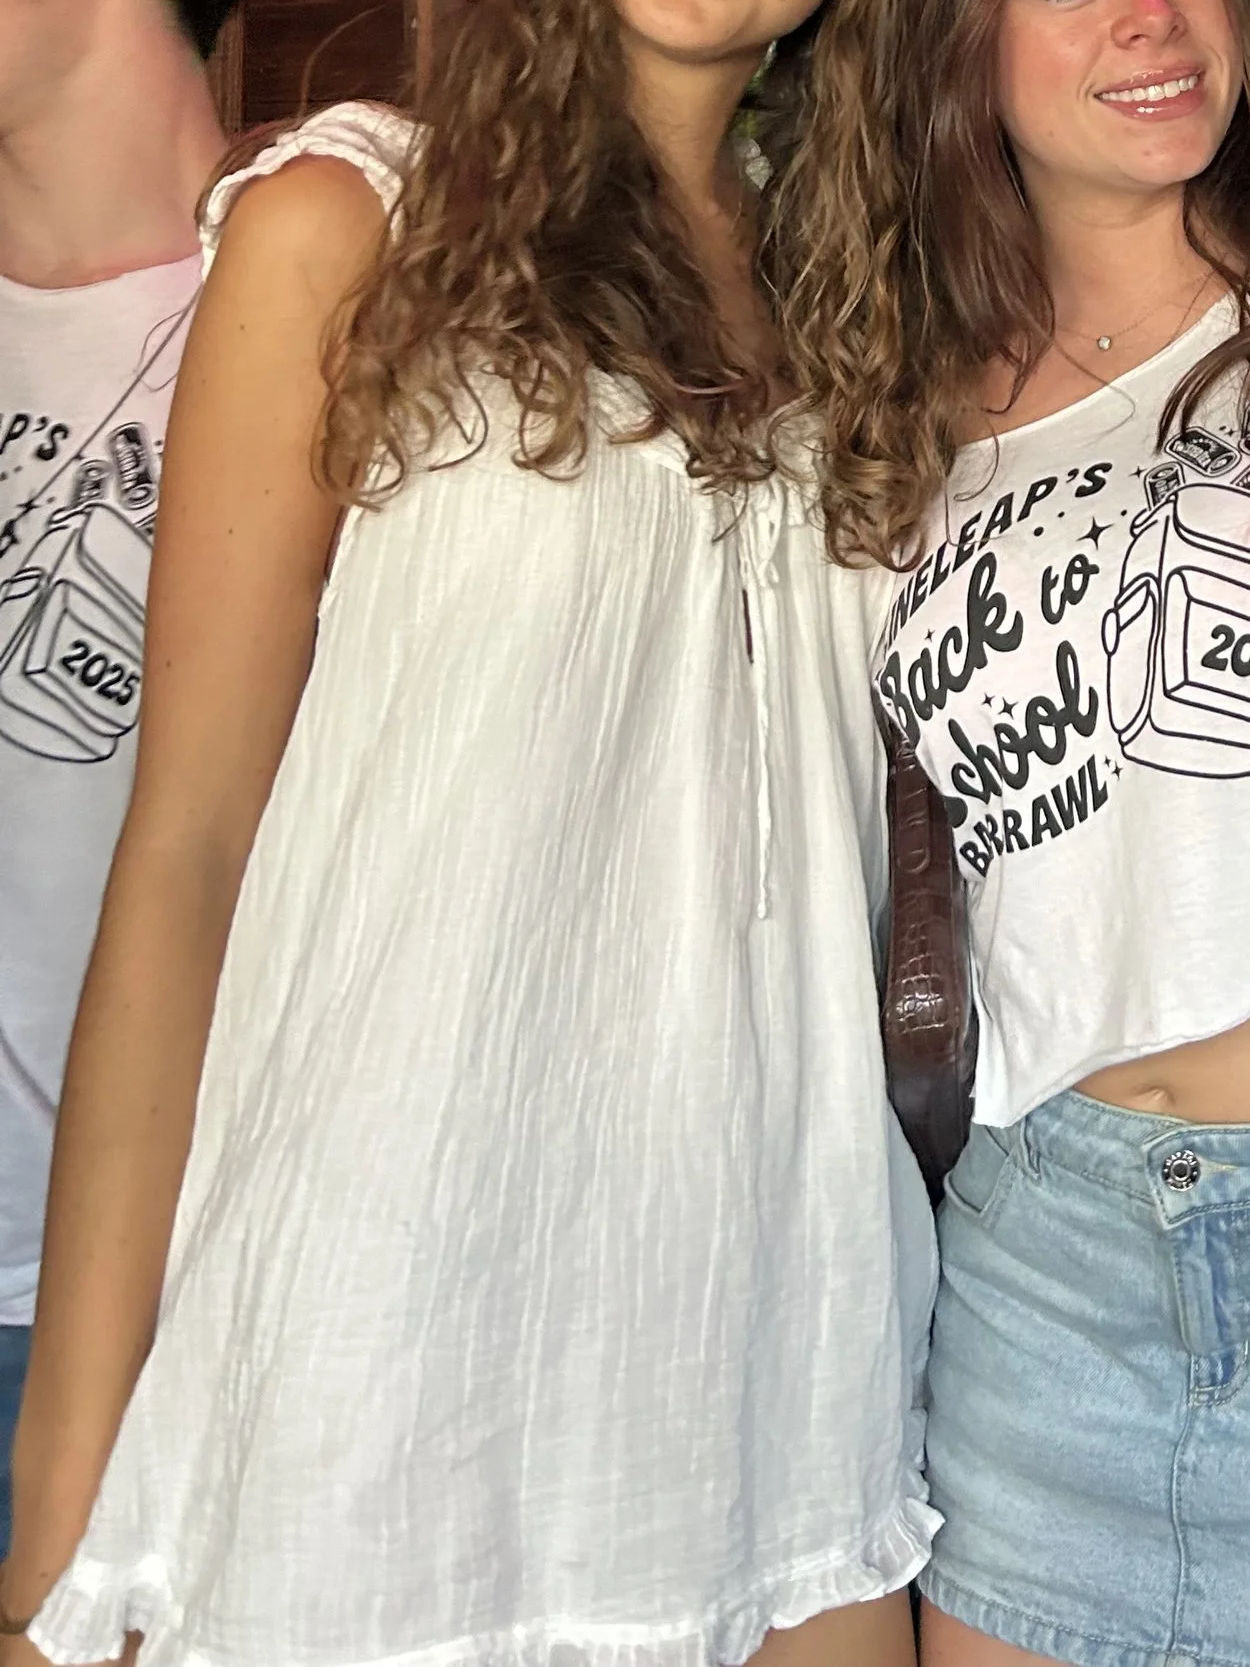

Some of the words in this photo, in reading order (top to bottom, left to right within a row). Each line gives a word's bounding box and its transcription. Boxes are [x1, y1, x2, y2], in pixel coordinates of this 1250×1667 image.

[0, 413, 69, 461] P'S
[61, 639, 141, 706] 2025
[880, 551, 1024, 747] Back
[1040, 553, 1100, 625] to
